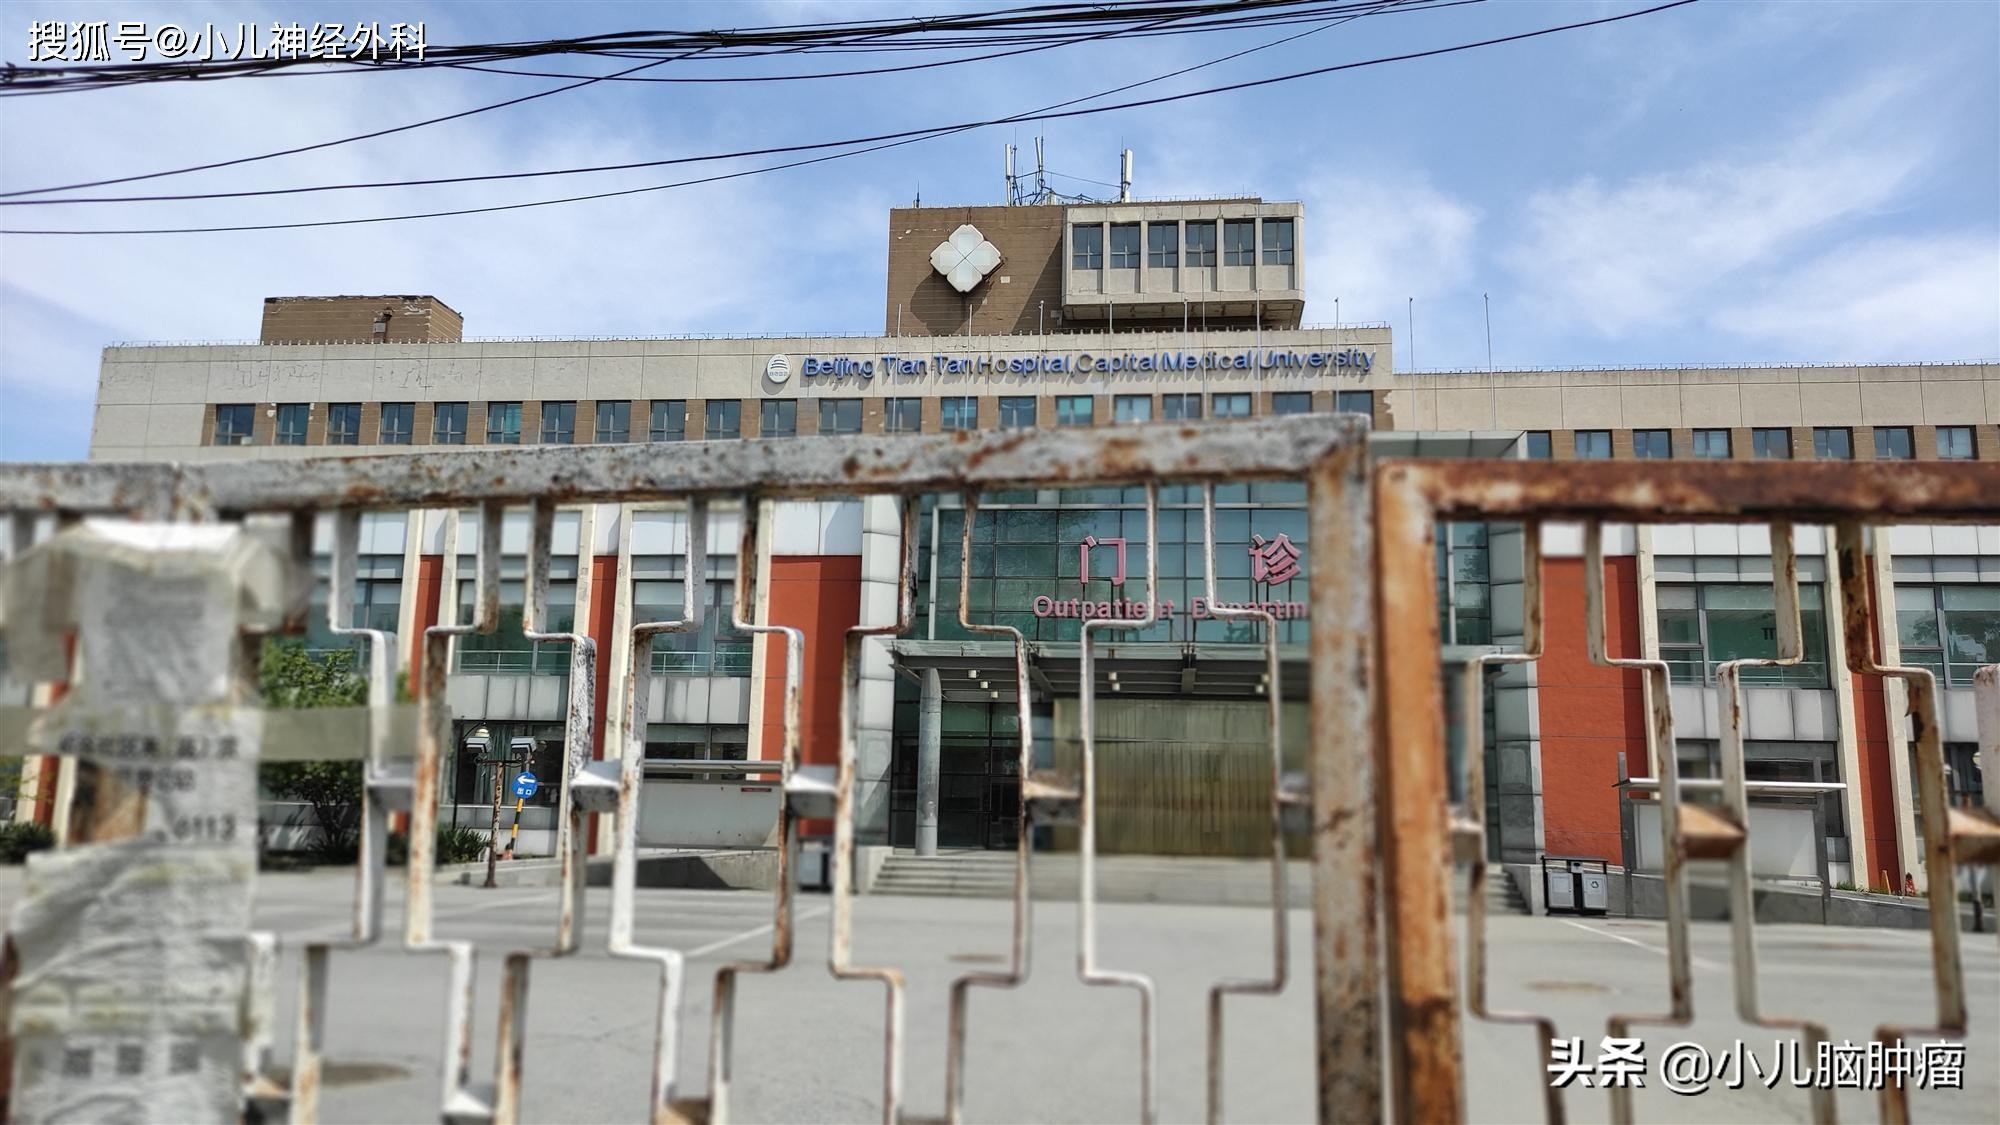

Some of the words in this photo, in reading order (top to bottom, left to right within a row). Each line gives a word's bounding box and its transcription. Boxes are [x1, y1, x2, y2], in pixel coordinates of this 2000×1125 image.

[804, 356, 874, 379] Beijing
[881, 355, 928, 374] Tian
[934, 354, 974, 374] Tan
[1077, 352, 1158, 376] Capital
[1162, 350, 1252, 371] Medical
[1258, 348, 1376, 371] University
